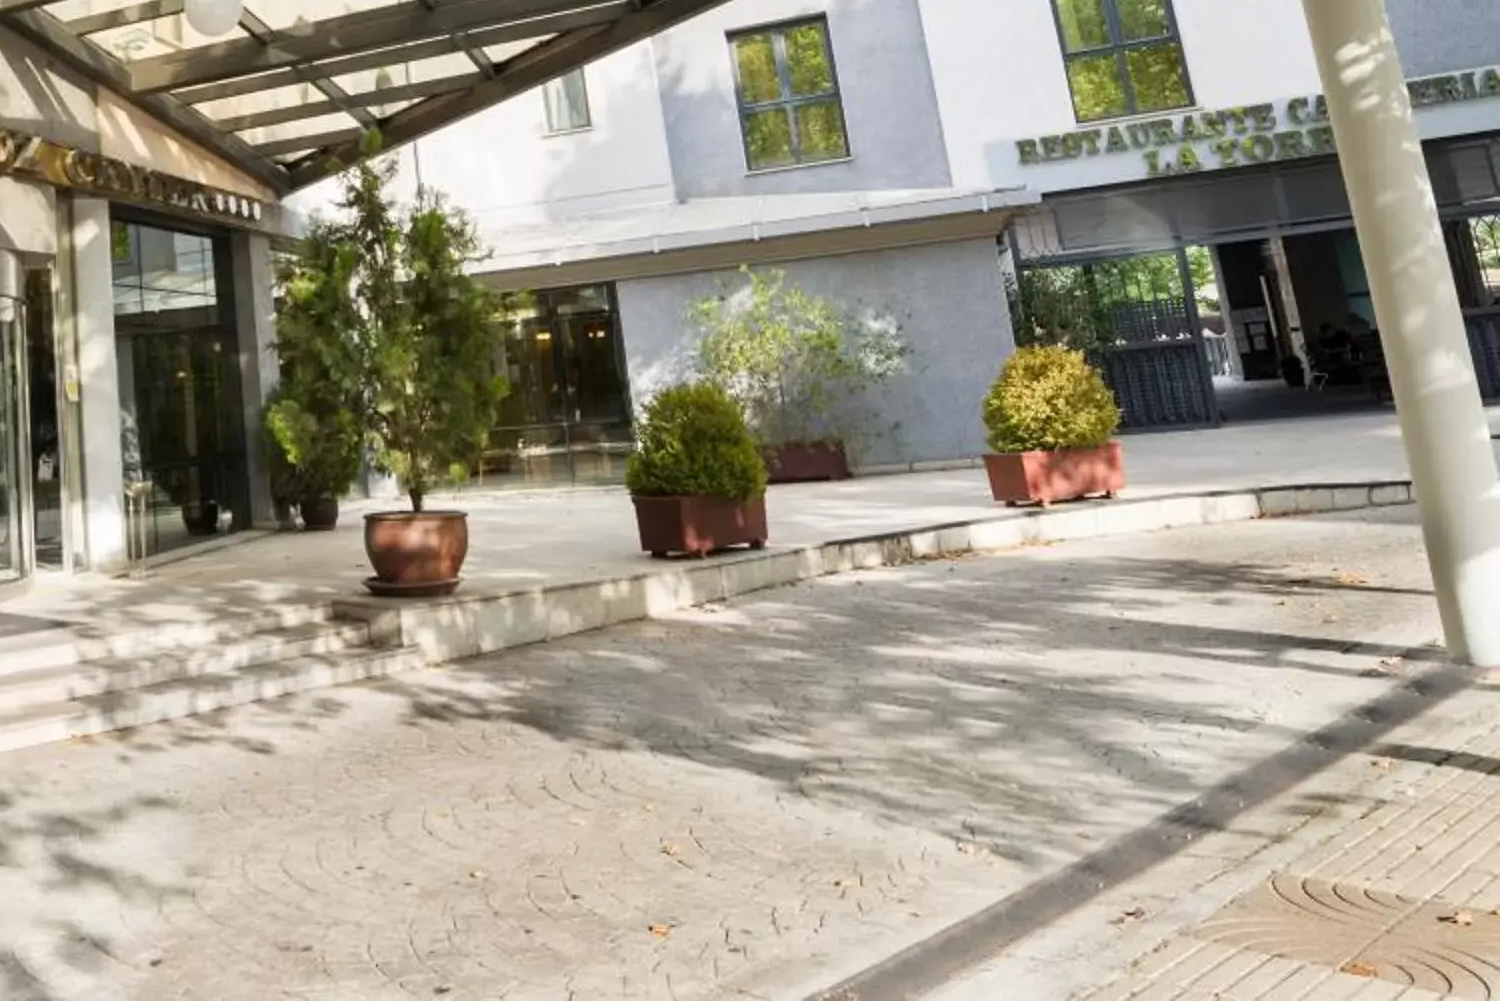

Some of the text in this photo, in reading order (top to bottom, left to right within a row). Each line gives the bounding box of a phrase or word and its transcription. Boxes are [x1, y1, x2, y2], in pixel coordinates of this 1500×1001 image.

[1015, 102, 1276, 165] RESTAURANTE
[1143, 125, 1336, 176] LA TORR
